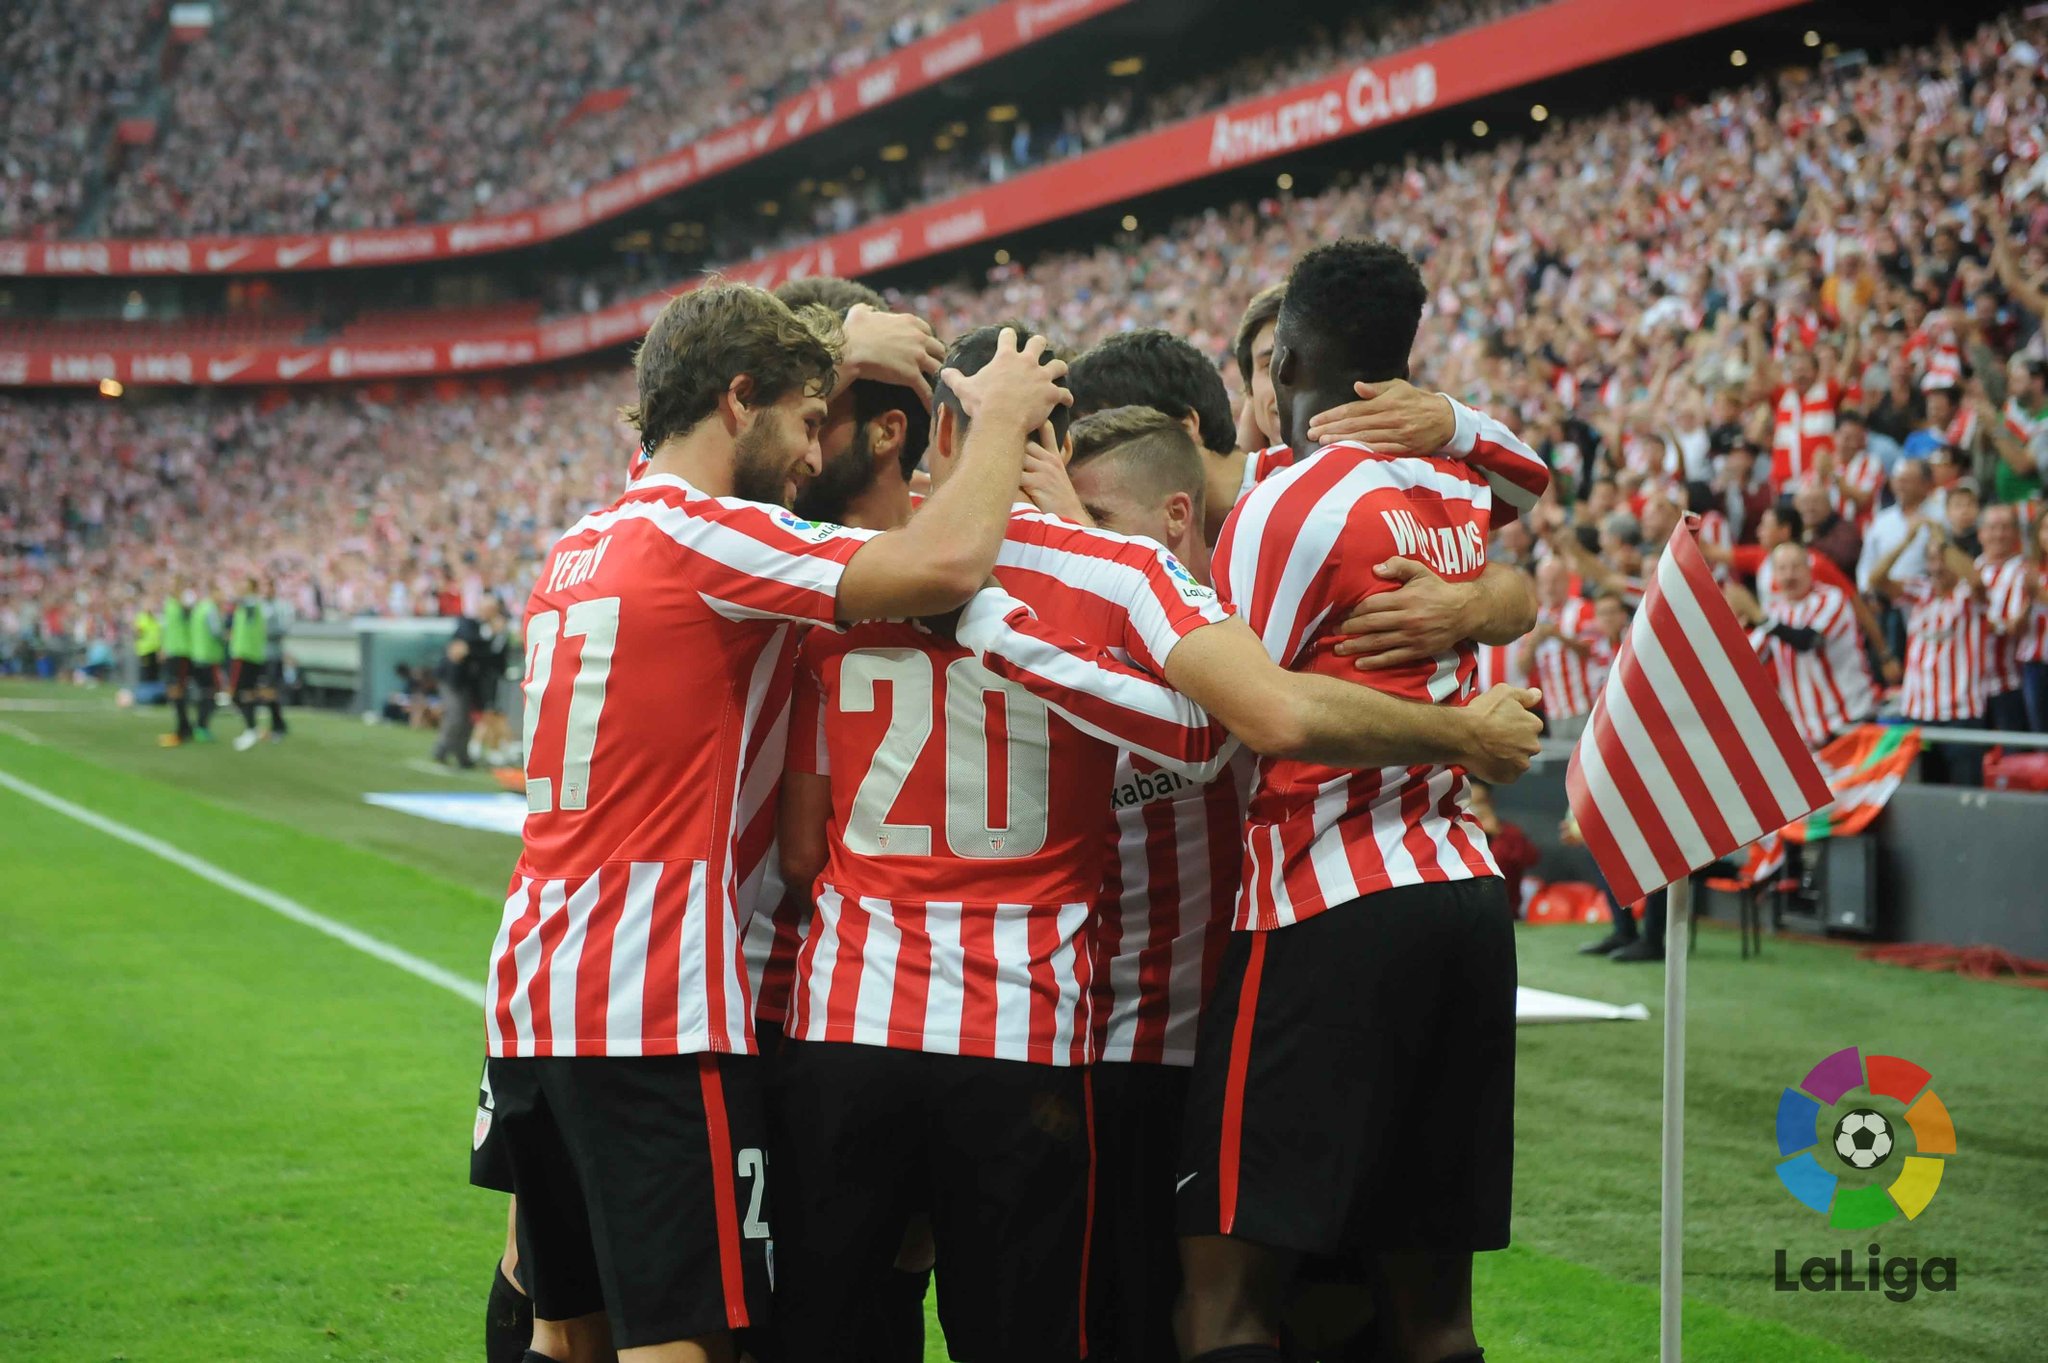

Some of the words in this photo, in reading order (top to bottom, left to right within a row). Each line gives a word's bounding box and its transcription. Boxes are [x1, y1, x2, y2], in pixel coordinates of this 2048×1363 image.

[545, 534, 613, 594] YERAY
[523, 597, 621, 814] 27
[839, 647, 1050, 859] 20
[737, 1147, 770, 1239] 2
